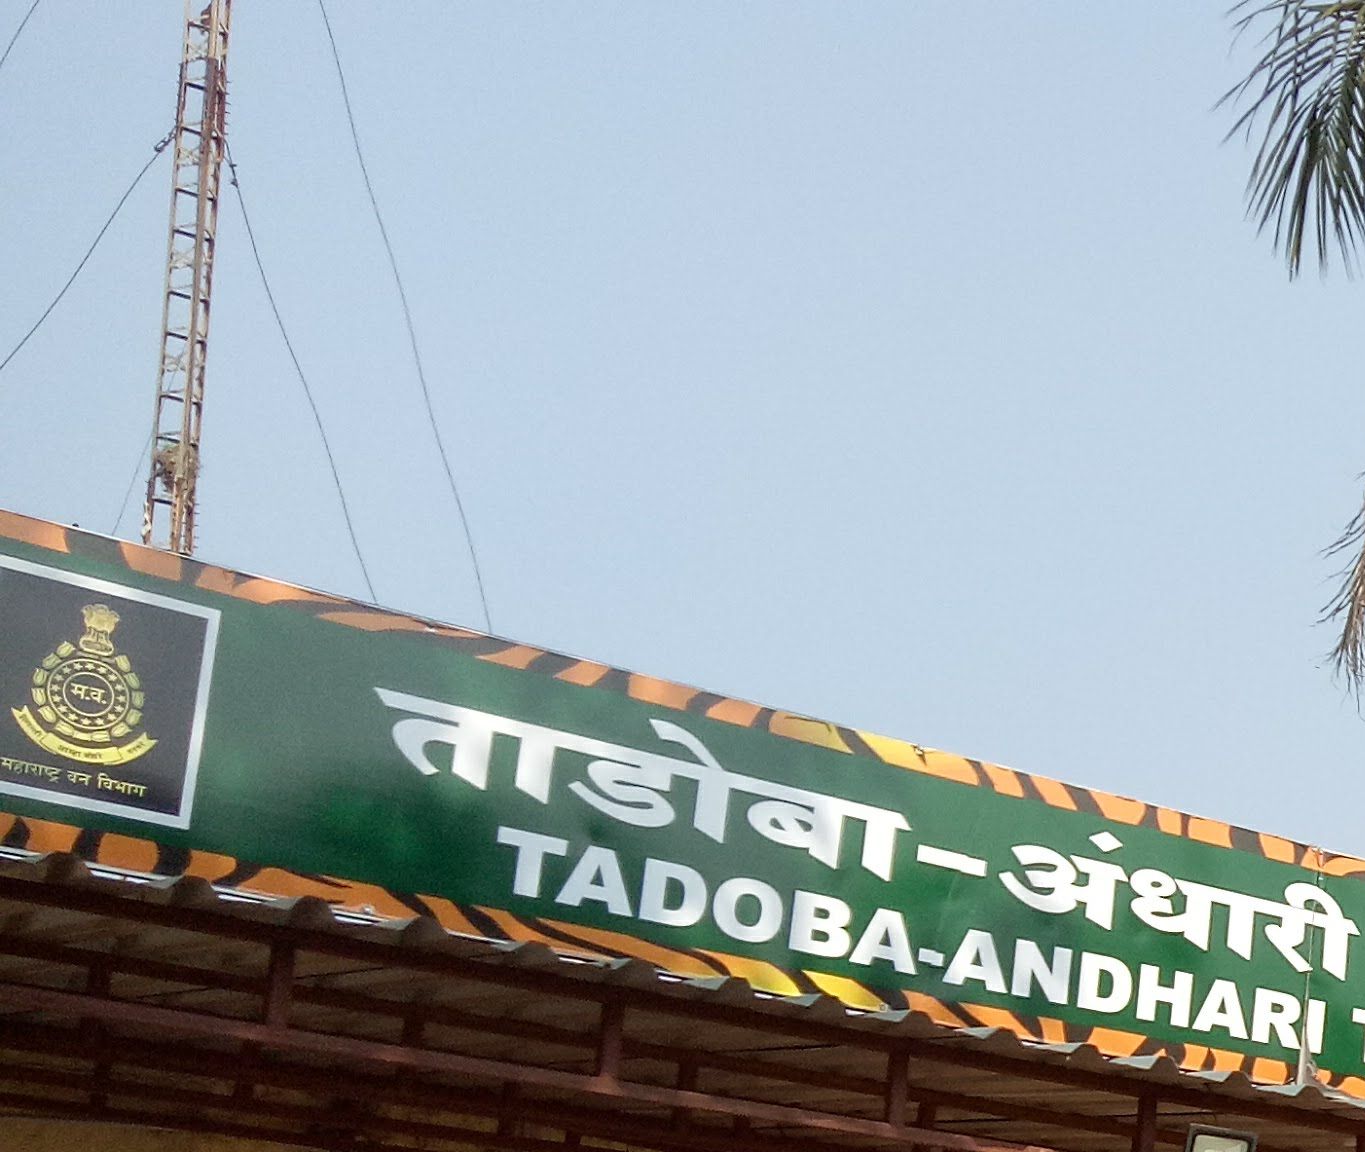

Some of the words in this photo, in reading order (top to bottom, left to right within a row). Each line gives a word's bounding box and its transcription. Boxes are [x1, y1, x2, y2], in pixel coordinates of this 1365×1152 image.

[1, 757, 62, 784] महाराष्ट्र
[67, 770, 92, 787] वन
[97, 772, 148, 798] विभाग
[497, 825, 1327, 1055] TADOBA-ANDHARI
